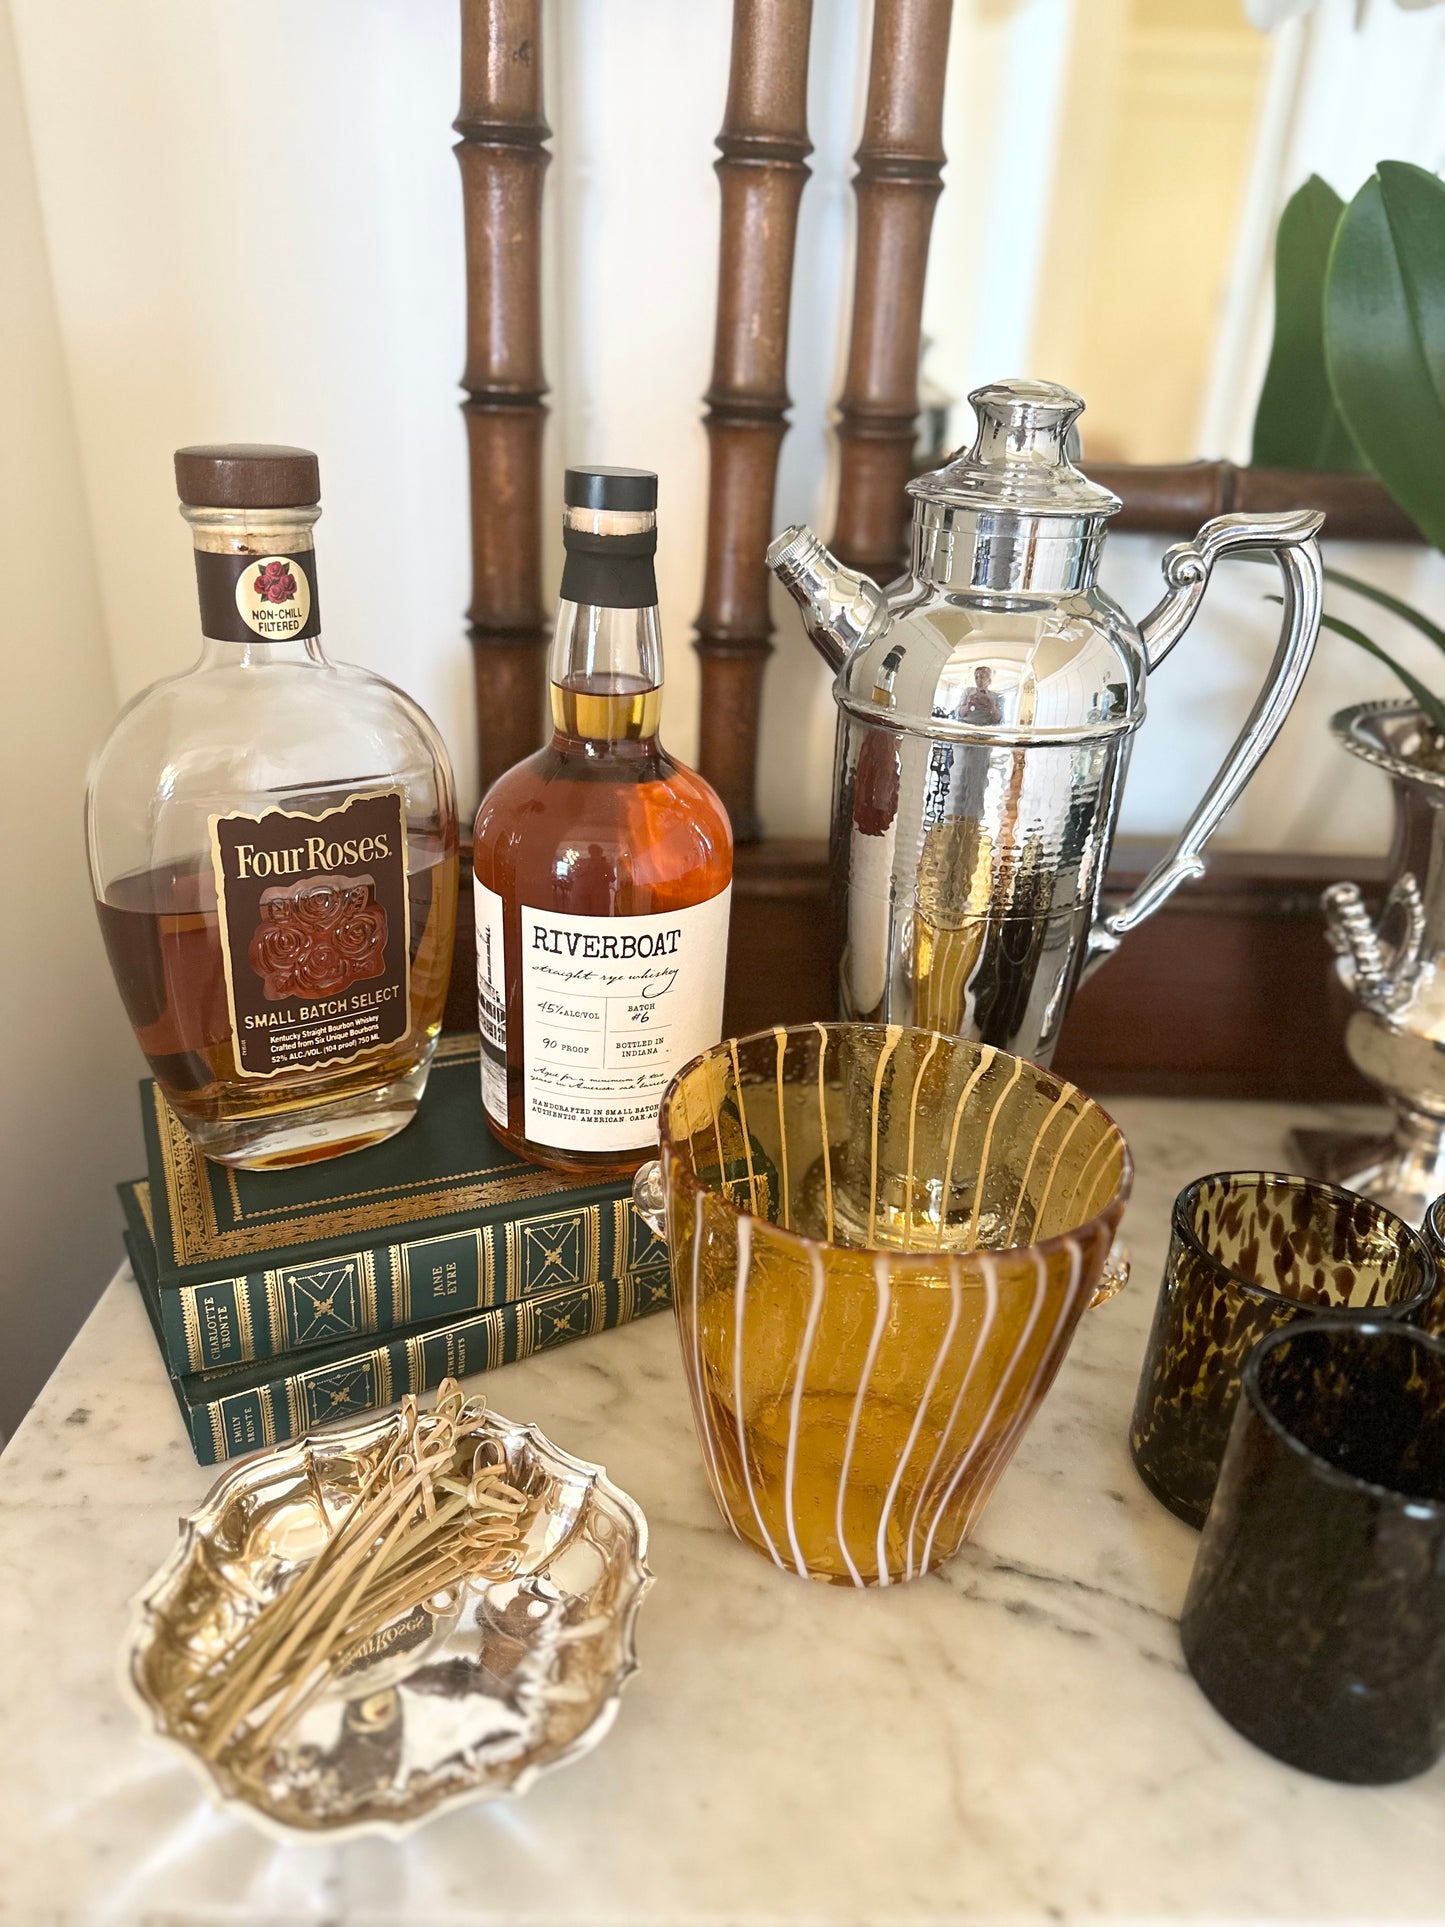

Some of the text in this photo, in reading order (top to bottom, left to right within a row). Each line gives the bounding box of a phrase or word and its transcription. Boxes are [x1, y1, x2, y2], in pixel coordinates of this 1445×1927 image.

[252, 608, 302, 620] NON-CHILL
[258, 620, 300, 633] FILTERED
[532, 925, 681, 959] RIVERBOAT
[532, 965, 680, 998] straight rye whiskey
[244, 984, 400, 1030] SMALL BATCH SELECT
[627, 1003, 656, 1012] BATCH
[631, 1011, 650, 1023] #6
[270, 1015, 380, 1044] Kentucky Straight Bourbon Whiskey
[270, 1023, 380, 1053] Crafted from Six Unique Bourbons
[615, 1037, 665, 1049] BOTTLED IN
[271, 1054, 289, 1064] 52%
[323, 1044, 338, 1055] (104
[338, 1039, 358, 1051] proof)
[358, 1036, 370, 1045] 750
[370, 1033, 381, 1041] ML
[542, 1037, 590, 1054] 90 PROOF
[621, 1047, 658, 1057] INDIANA
[568, 1081, 615, 1091] American
[532, 1097, 591, 1115] HANDCRAFTED
[605, 1107, 633, 1116] SMALL
[432, 1265, 446, 1298] JANE
[446, 1261, 457, 1295] EYRE
[204, 1296, 221, 1360] CHARLOTTE
[217, 1305, 232, 1350] BRONTE
[458, 1337, 466, 1375] HEIGHTS
[232, 1416, 243, 1444] EMILY
[244, 1407, 256, 1443] BRONTE
